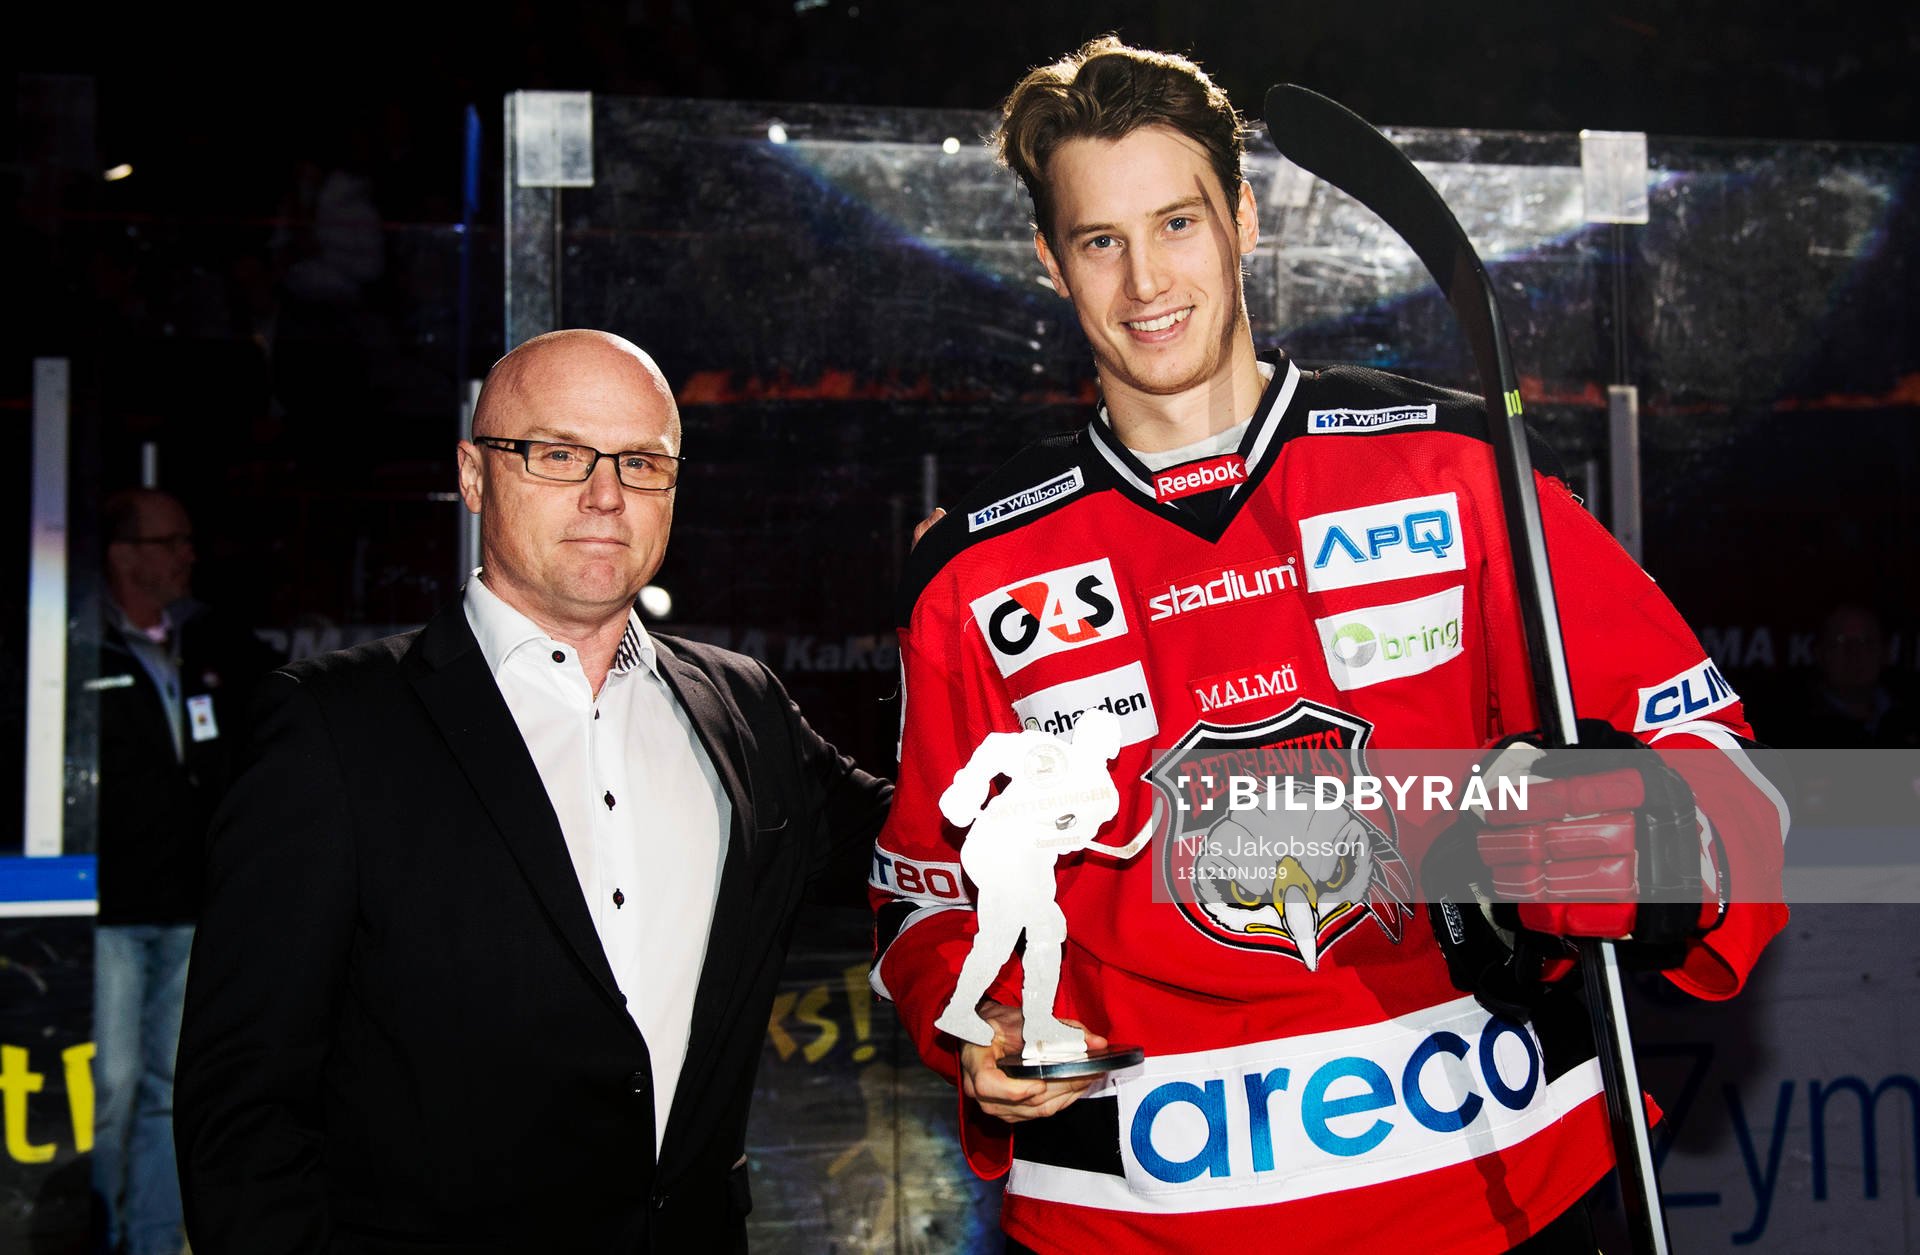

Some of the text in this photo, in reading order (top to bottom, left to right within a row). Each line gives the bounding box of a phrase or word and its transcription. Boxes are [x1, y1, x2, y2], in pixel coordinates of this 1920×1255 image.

[1353, 411, 1427, 426] Wihlborgs
[1007, 478, 1077, 511] Wihlborgs
[1158, 462, 1243, 496] Reebok
[988, 574, 1114, 656] G4S
[1379, 618, 1459, 661] bring
[1195, 664, 1298, 712] MALMÖ
[1044, 693, 1147, 736] chden
[1180, 728, 1349, 820] REDHAWKS
[1130, 1014, 1540, 1184] areco
